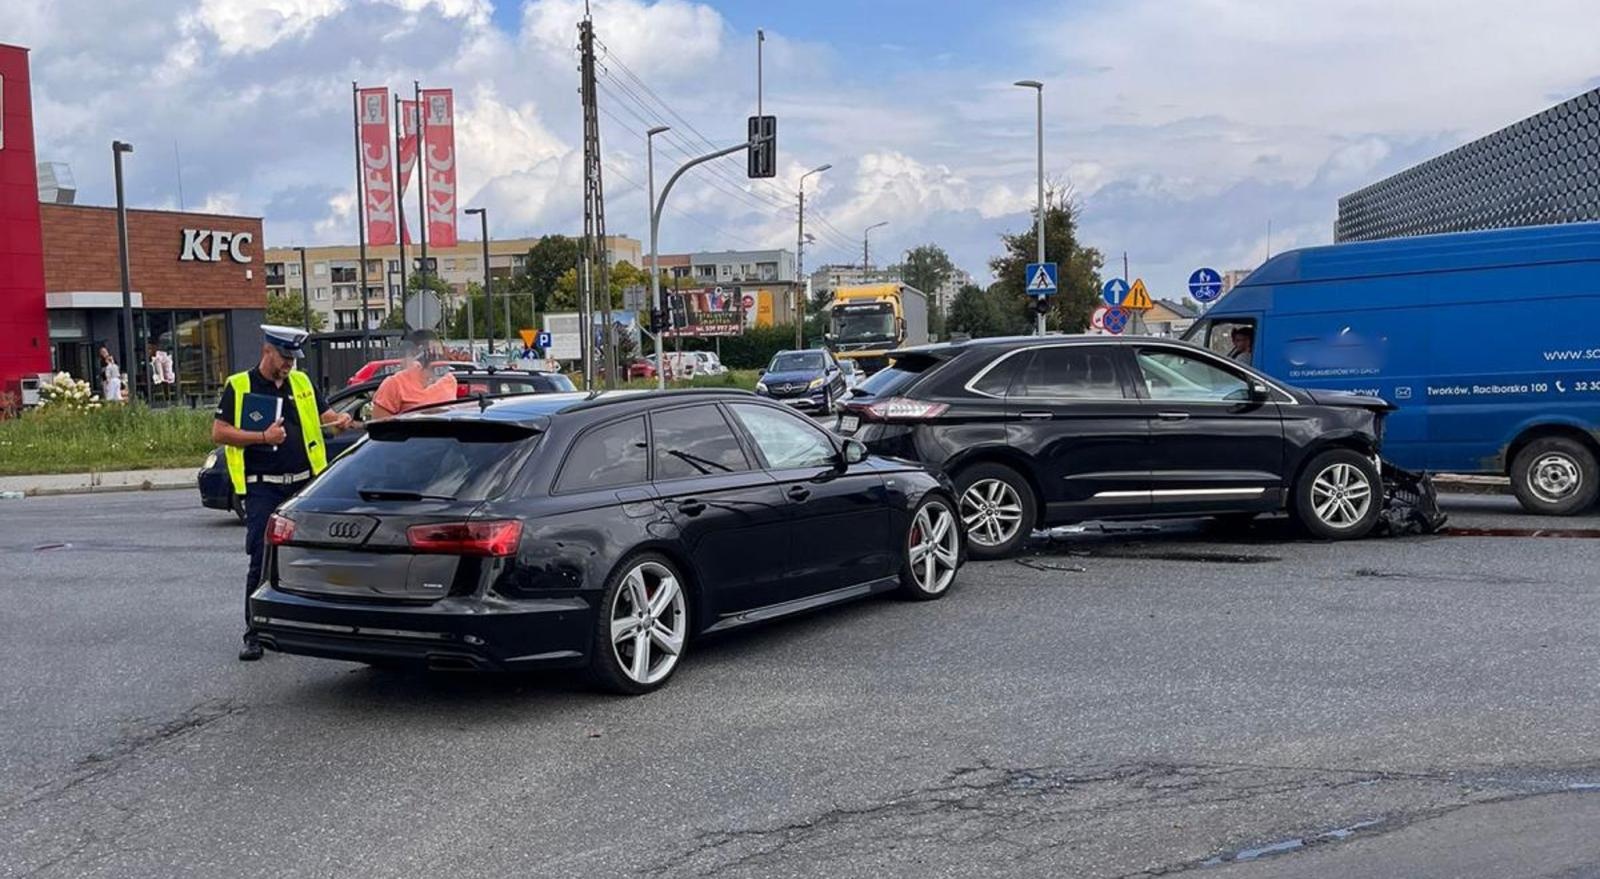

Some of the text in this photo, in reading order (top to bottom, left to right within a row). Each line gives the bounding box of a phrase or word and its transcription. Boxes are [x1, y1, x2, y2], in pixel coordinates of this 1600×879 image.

[364, 142, 393, 224] KFC
[427, 143, 454, 224] KFC
[181, 229, 252, 263] KFC
[540, 333, 549, 346] P
[1427, 383, 1548, 396] Tworków, Raciborska 100
[1574, 382, 1587, 391] 32
